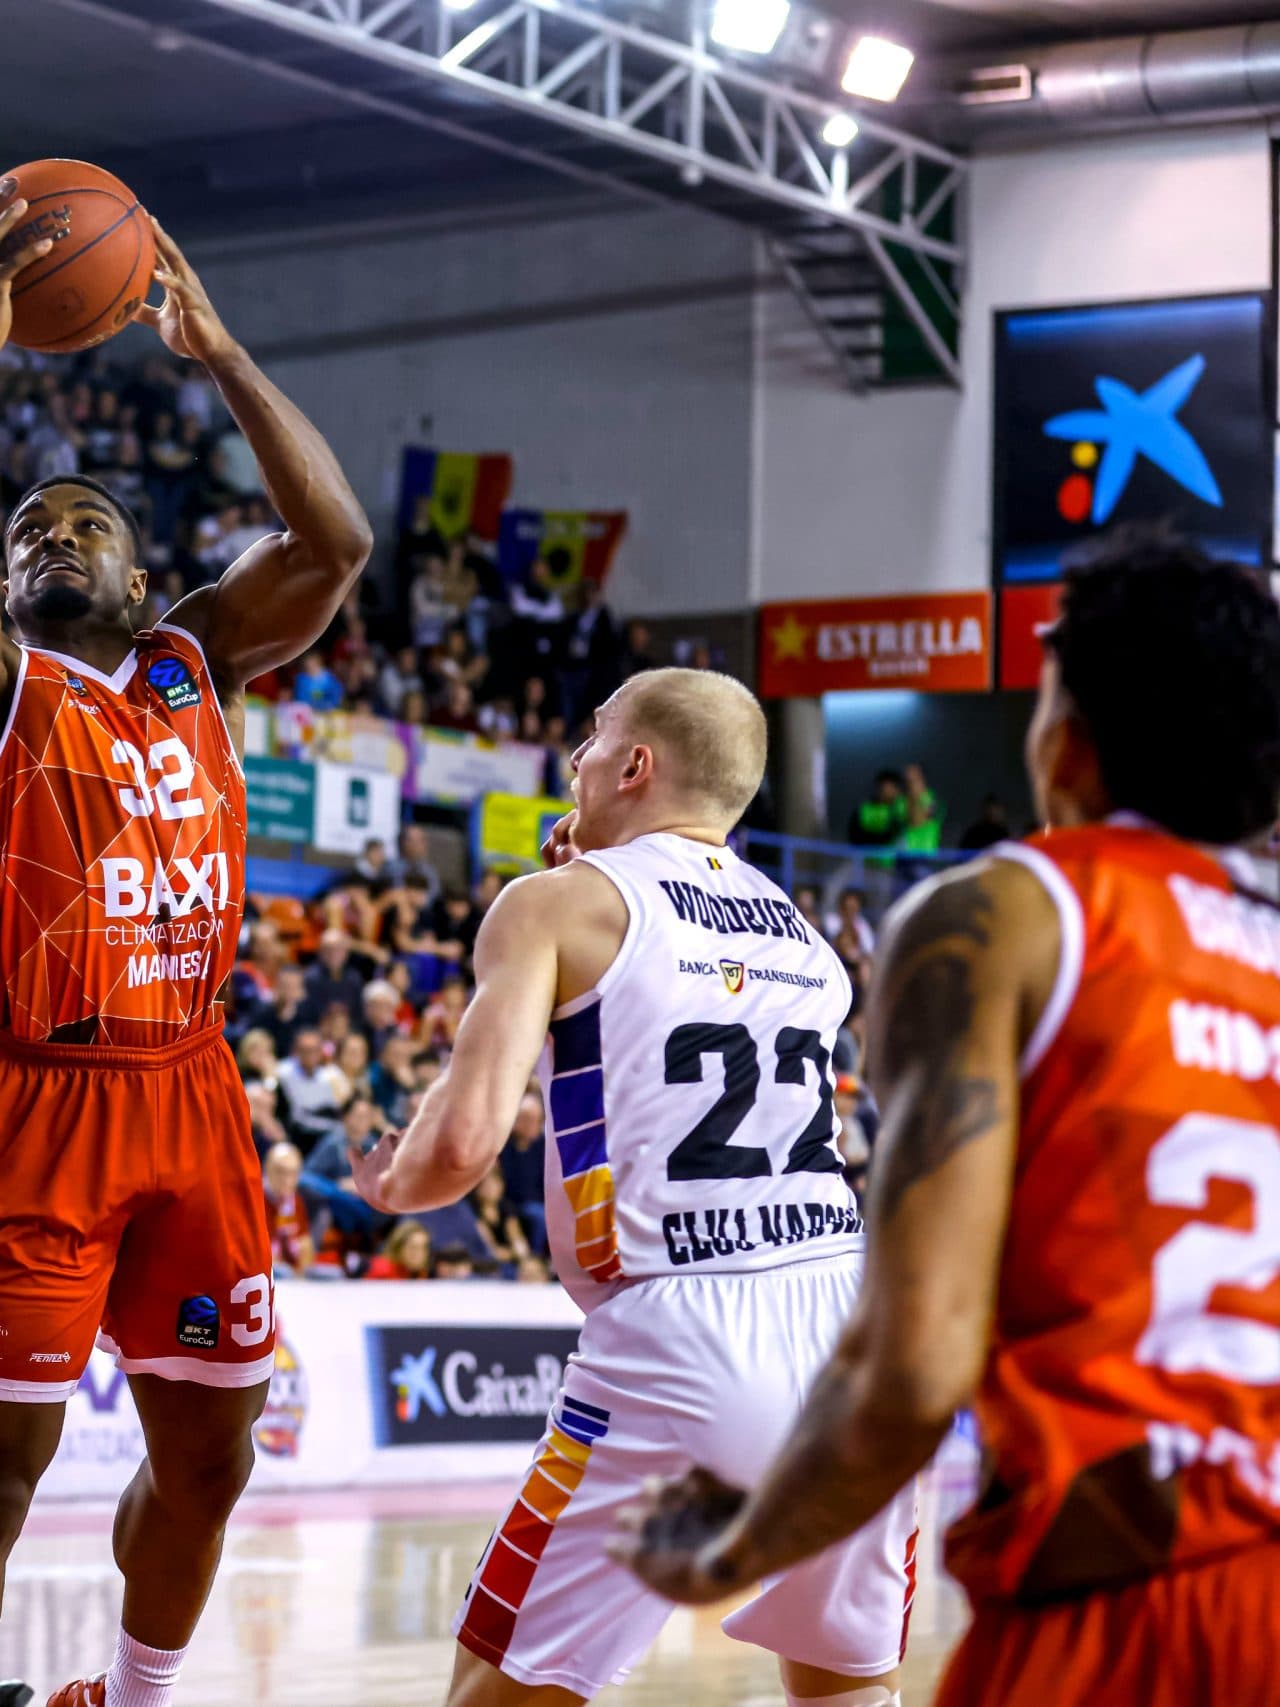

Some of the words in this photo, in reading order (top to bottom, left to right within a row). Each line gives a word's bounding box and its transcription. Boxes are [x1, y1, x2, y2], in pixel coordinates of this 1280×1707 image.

[817, 616, 983, 662] ESTRELLA
[167, 693, 199, 708] EuroCup
[111, 737, 206, 821] 32
[100, 852, 230, 918] BAXI
[679, 959, 718, 976] BANCA
[664, 1022, 845, 1182] 22
[230, 1272, 276, 1347] 3
[179, 1334, 215, 1347] EuroCup
